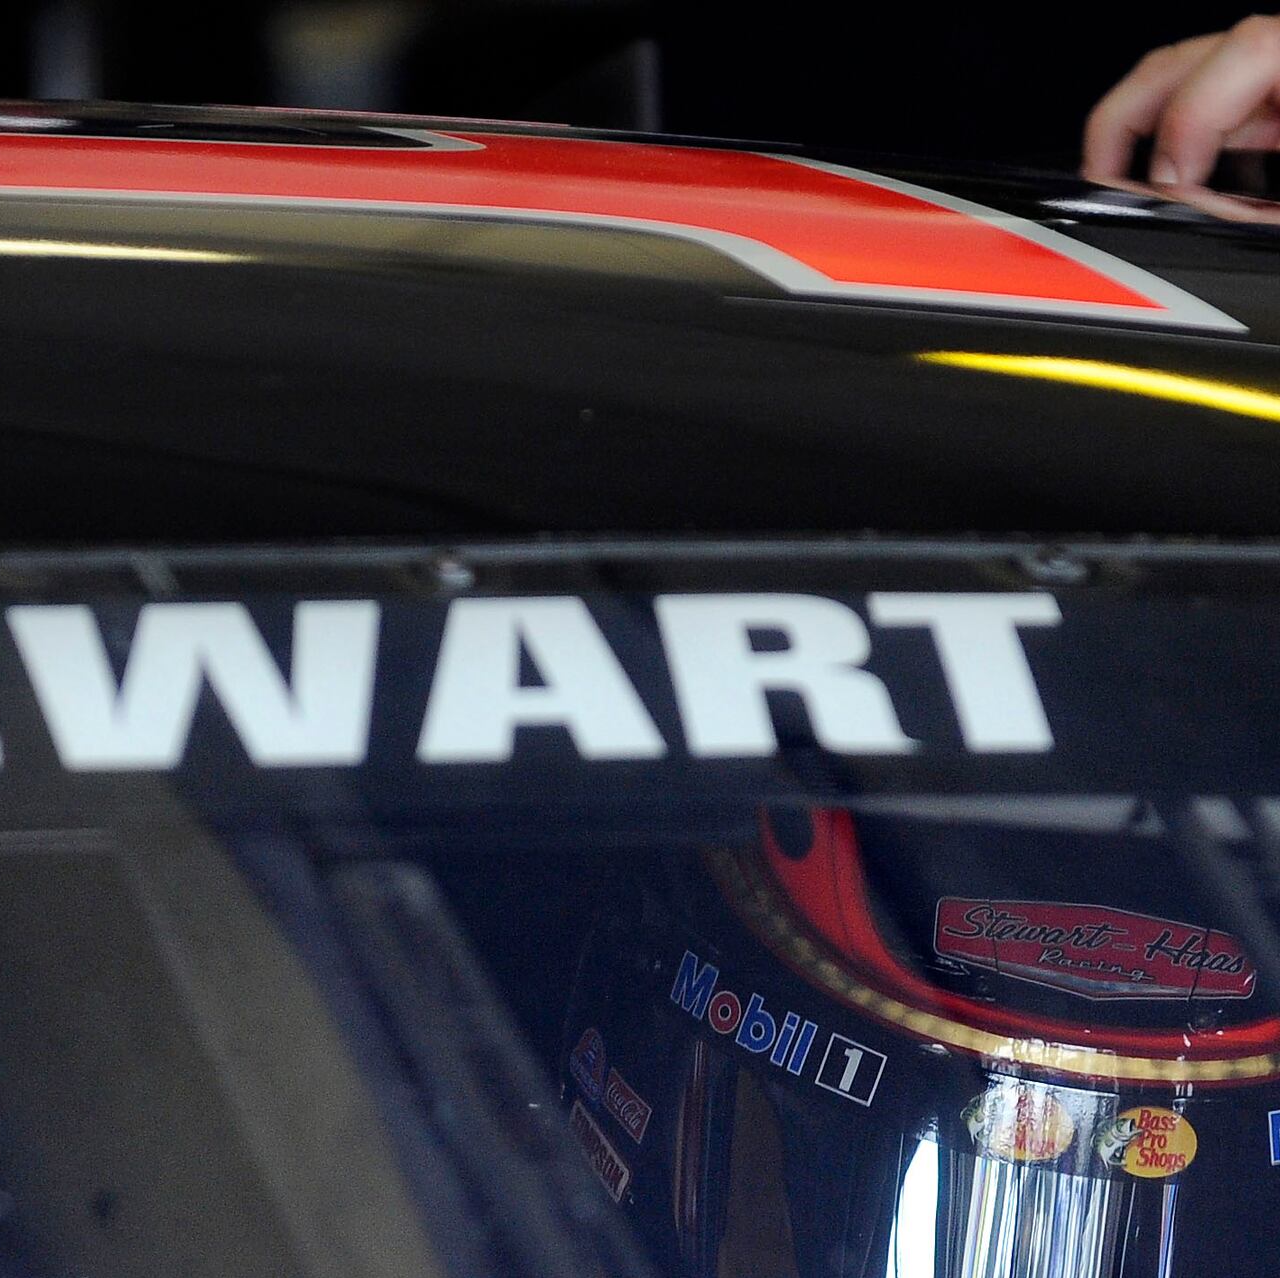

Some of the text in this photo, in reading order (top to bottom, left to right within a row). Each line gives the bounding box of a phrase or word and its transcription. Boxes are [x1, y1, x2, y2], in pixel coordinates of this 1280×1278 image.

[1037, 949, 1154, 982] Racing
[670, 950, 819, 1077] Mobil
[838, 1047, 864, 1093] 1
[1137, 1108, 1178, 1132] Bass
[1138, 1129, 1168, 1150] Pro
[1135, 1147, 1187, 1174] Shops
